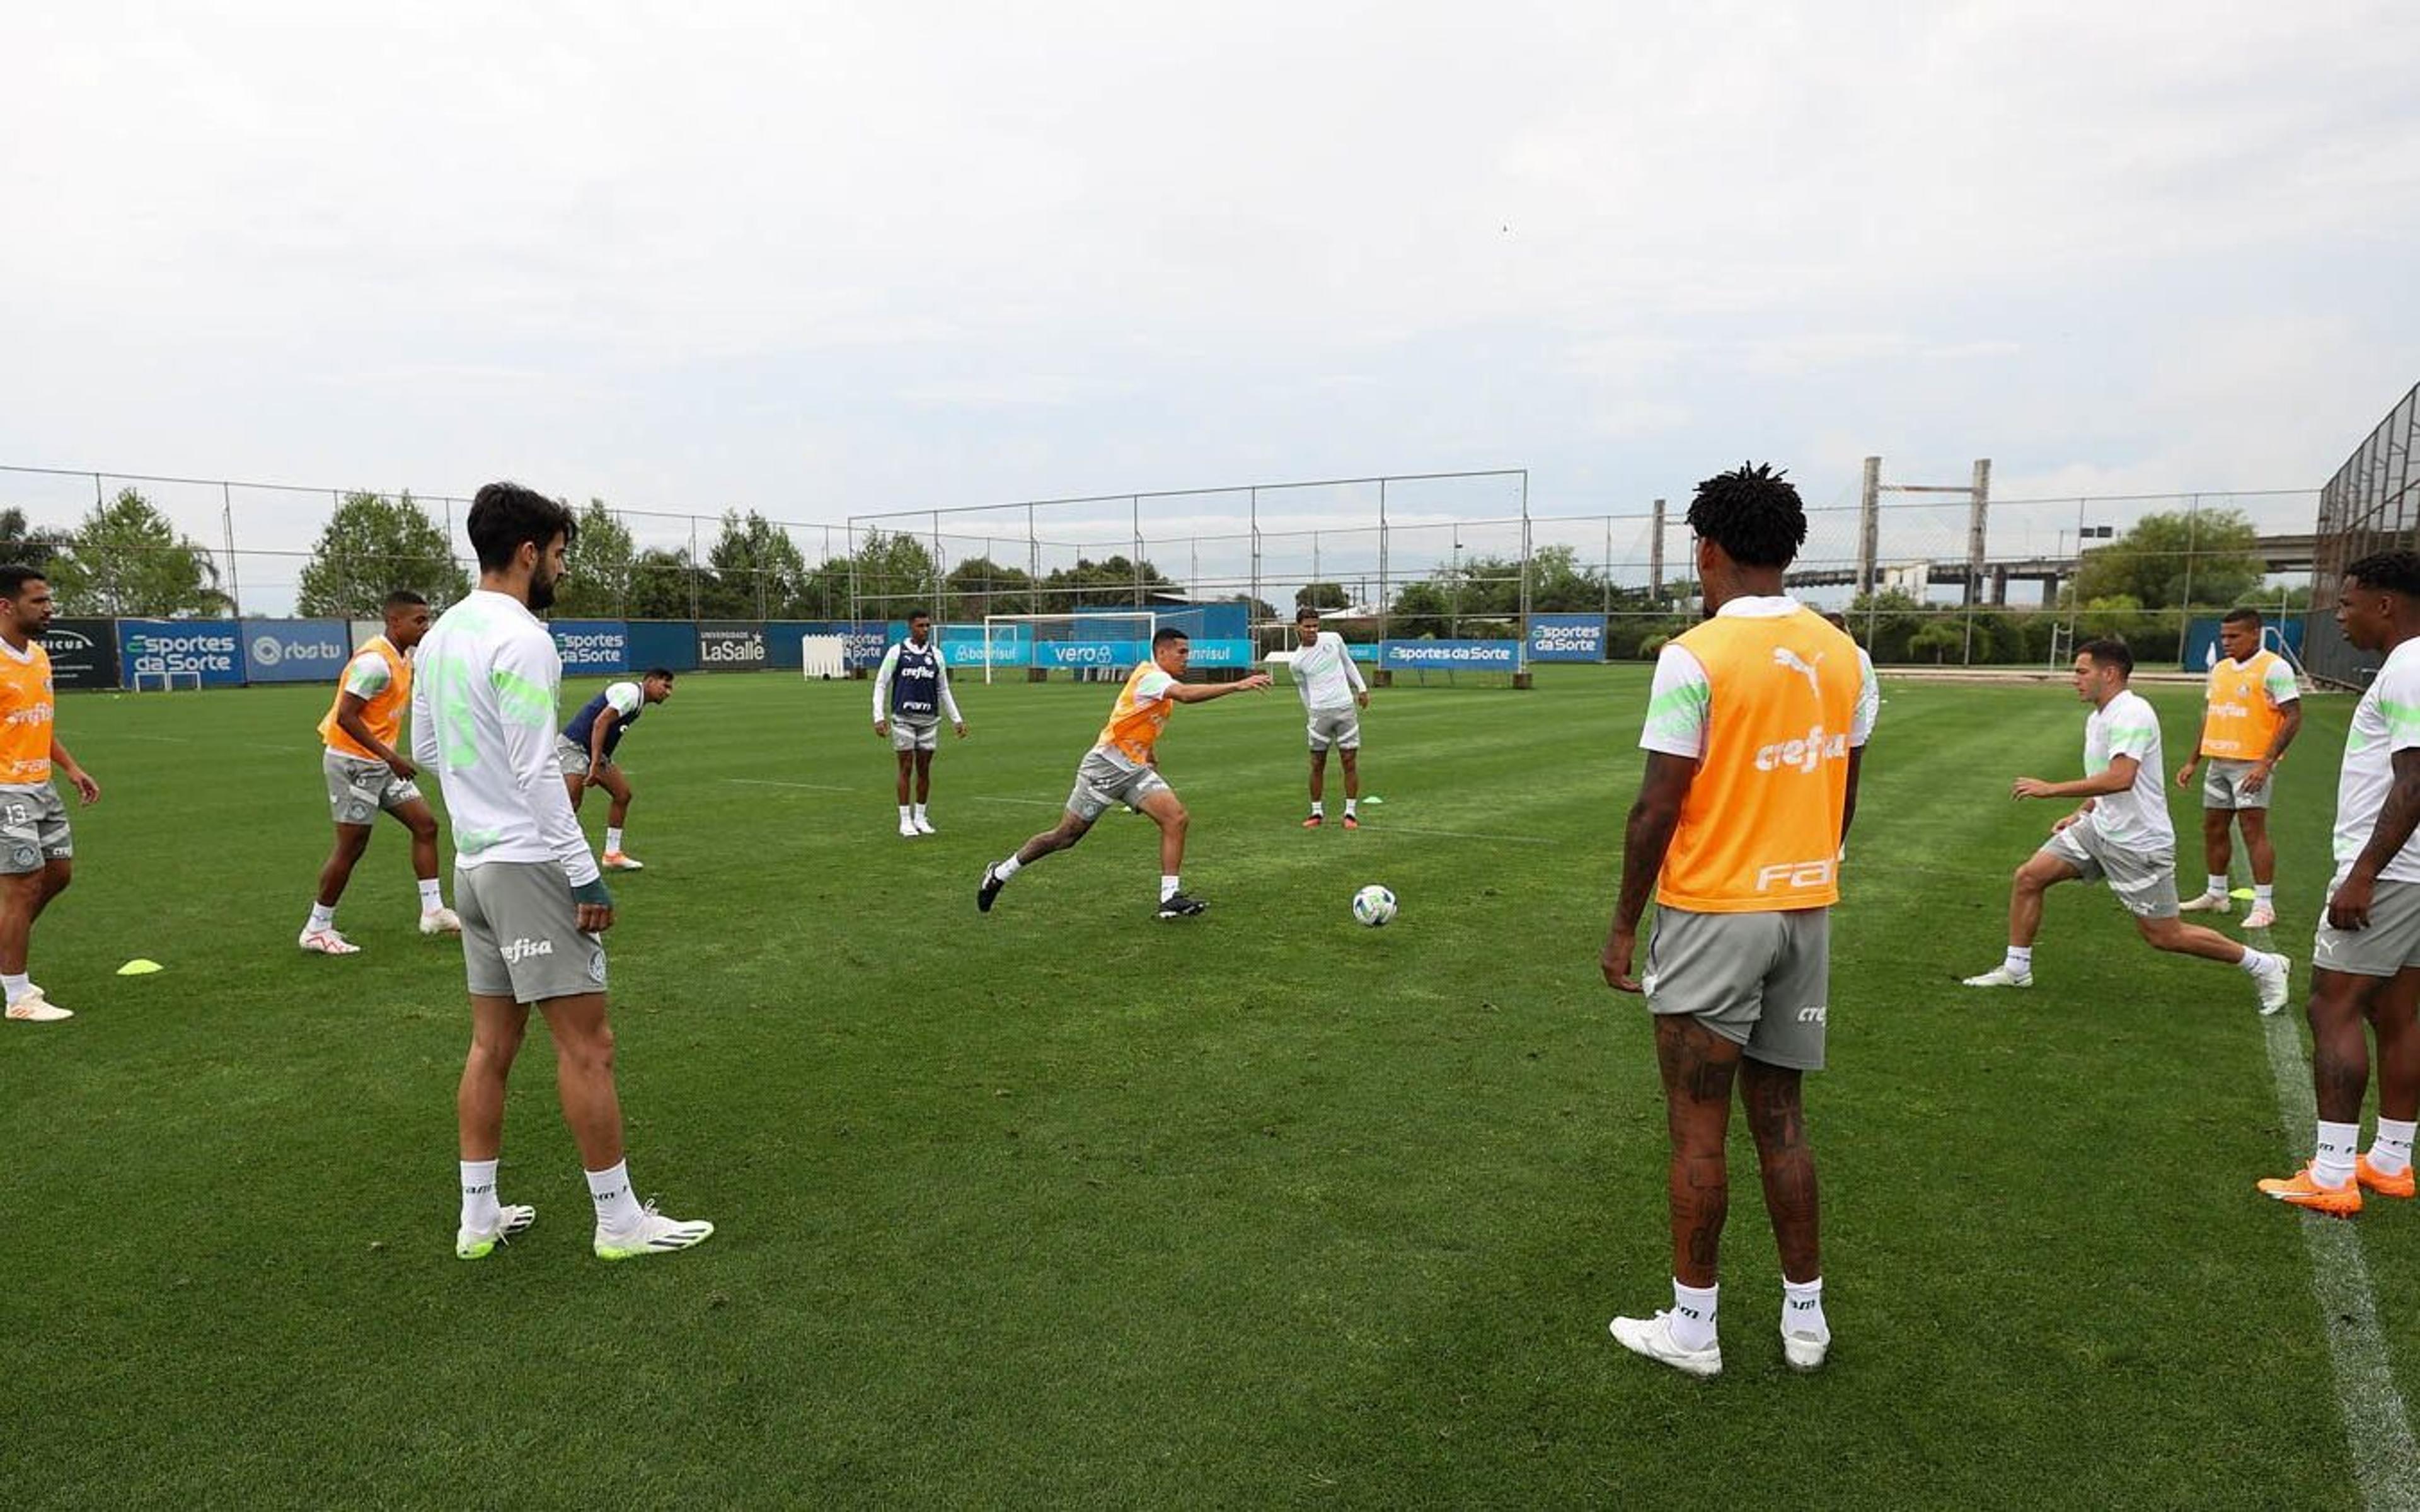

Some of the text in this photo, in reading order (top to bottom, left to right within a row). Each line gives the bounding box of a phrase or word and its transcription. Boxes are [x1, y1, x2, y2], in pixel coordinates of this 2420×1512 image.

[1533, 625, 1600, 641] Esportes
[127, 635, 235, 656] Esportes
[556, 633, 625, 651] Esportes
[1055, 646, 1095, 662] vero
[1389, 646, 1450, 662] Esportes
[6, 803, 26, 824] 13
